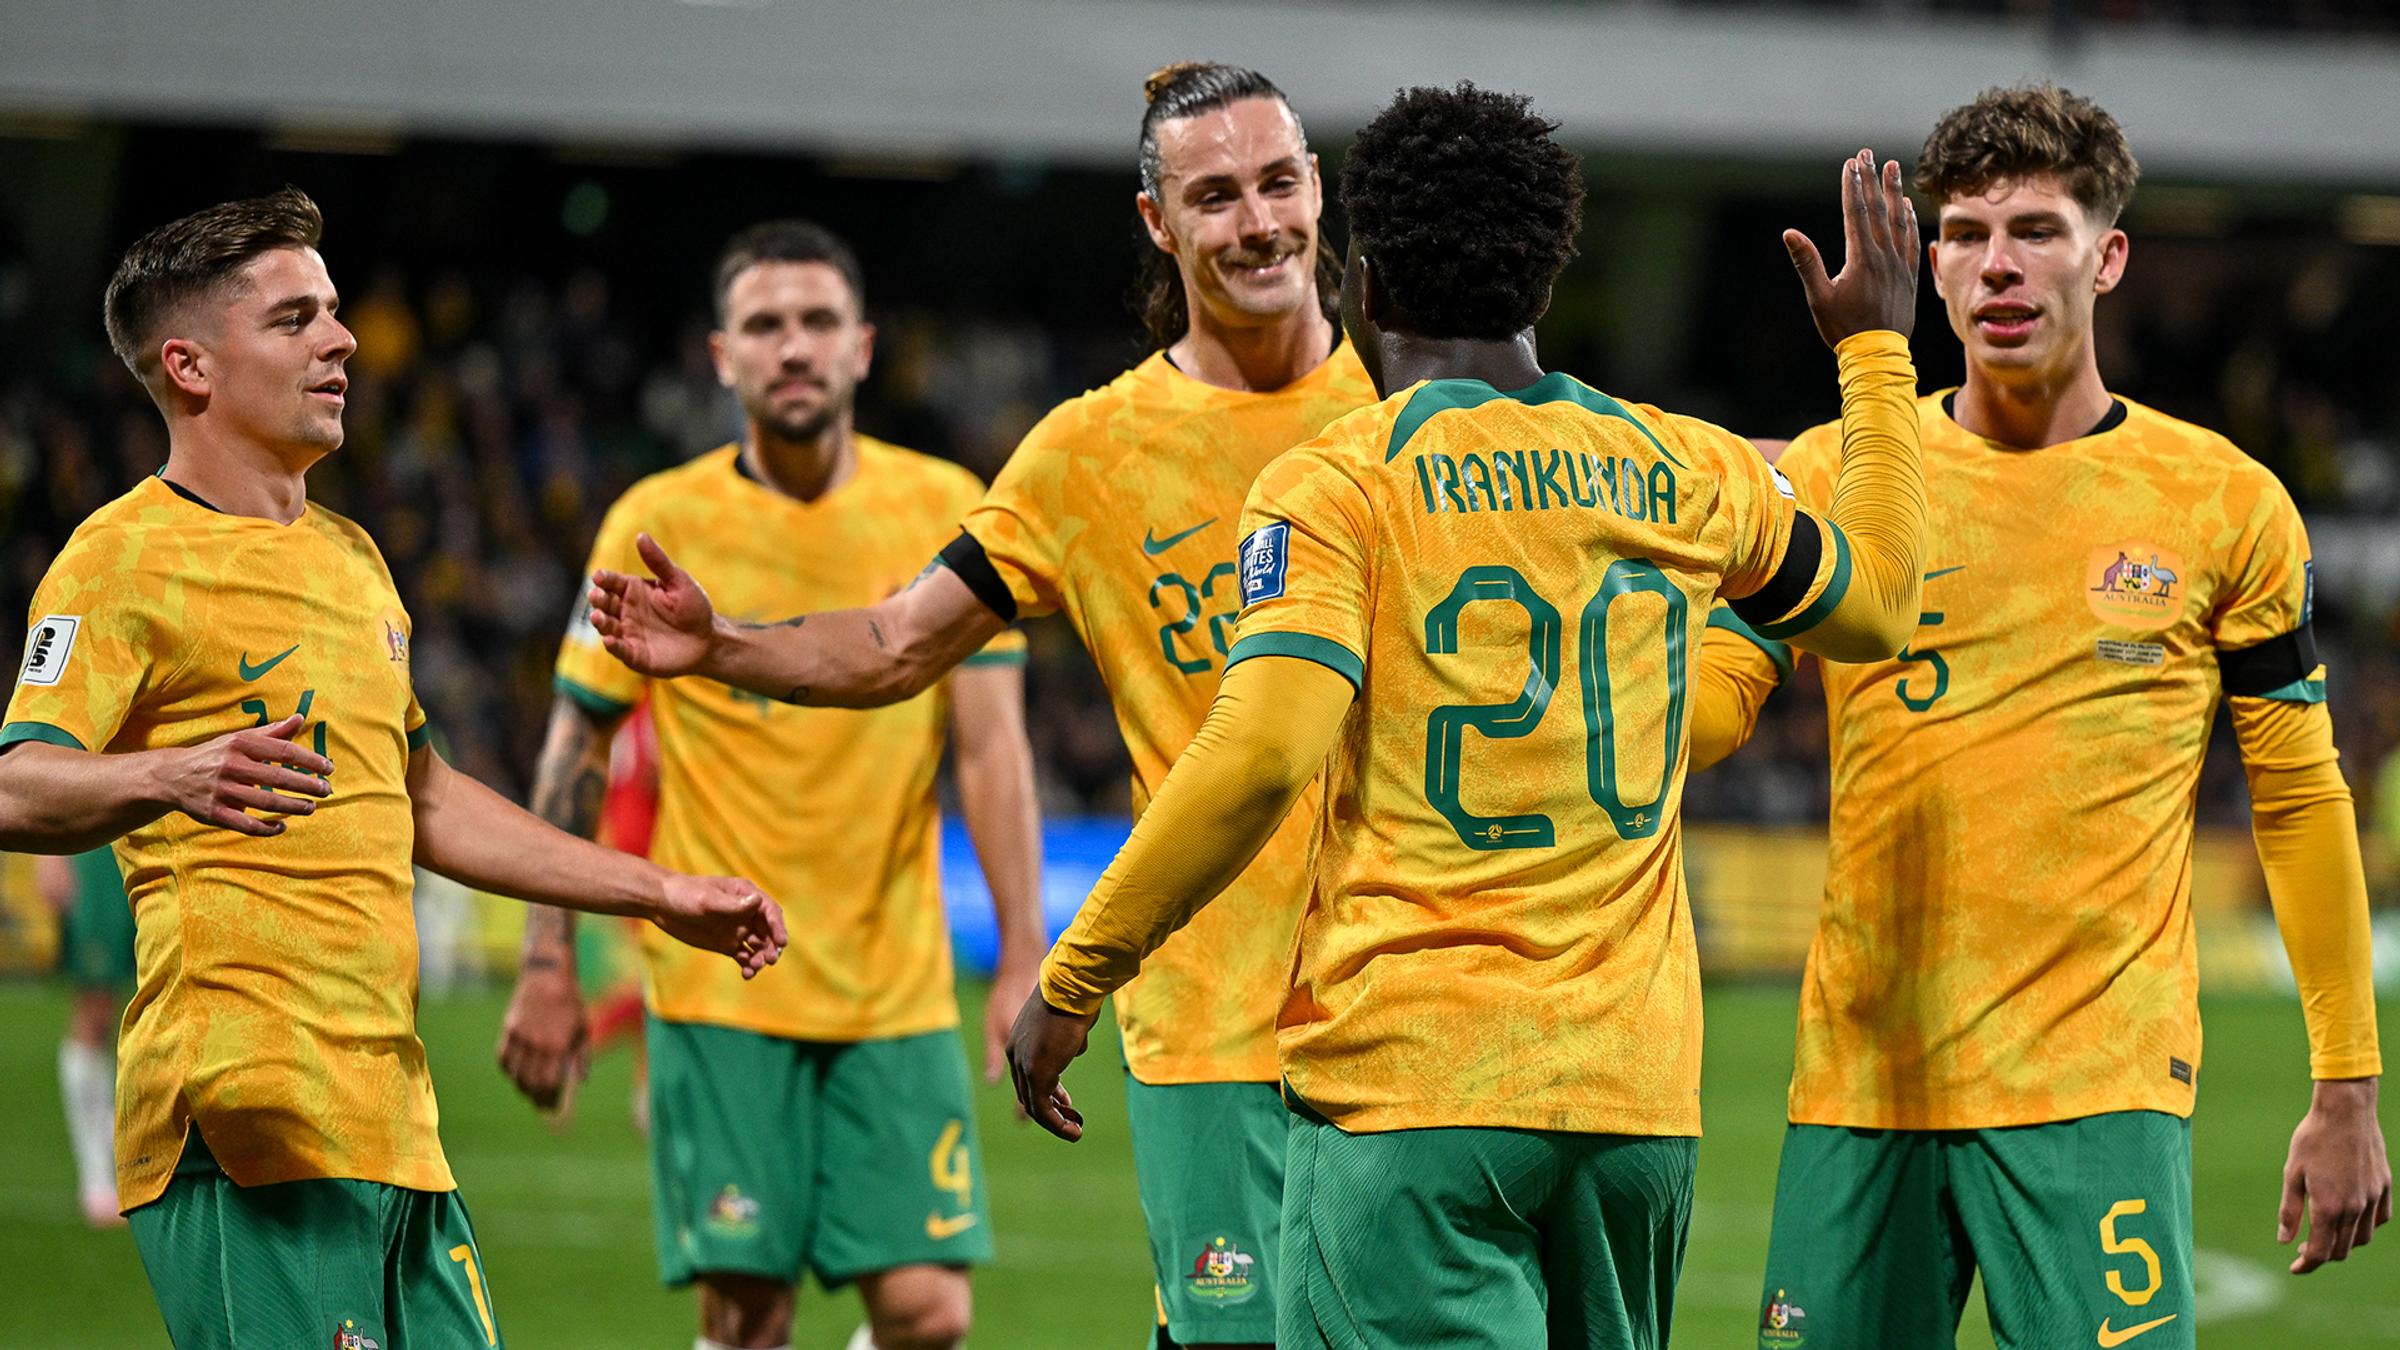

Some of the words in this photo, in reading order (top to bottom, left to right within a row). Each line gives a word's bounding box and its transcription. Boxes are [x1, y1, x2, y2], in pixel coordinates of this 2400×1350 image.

[1415, 449, 1677, 524] IRANKUNDA
[2104, 594, 2166, 606] AUSTRALIA
[1425, 557, 1688, 851] 20
[1895, 612, 1949, 712] 5
[931, 1119, 971, 1207] 4
[449, 1243, 497, 1347] 1
[2099, 1199, 2162, 1306] 5
